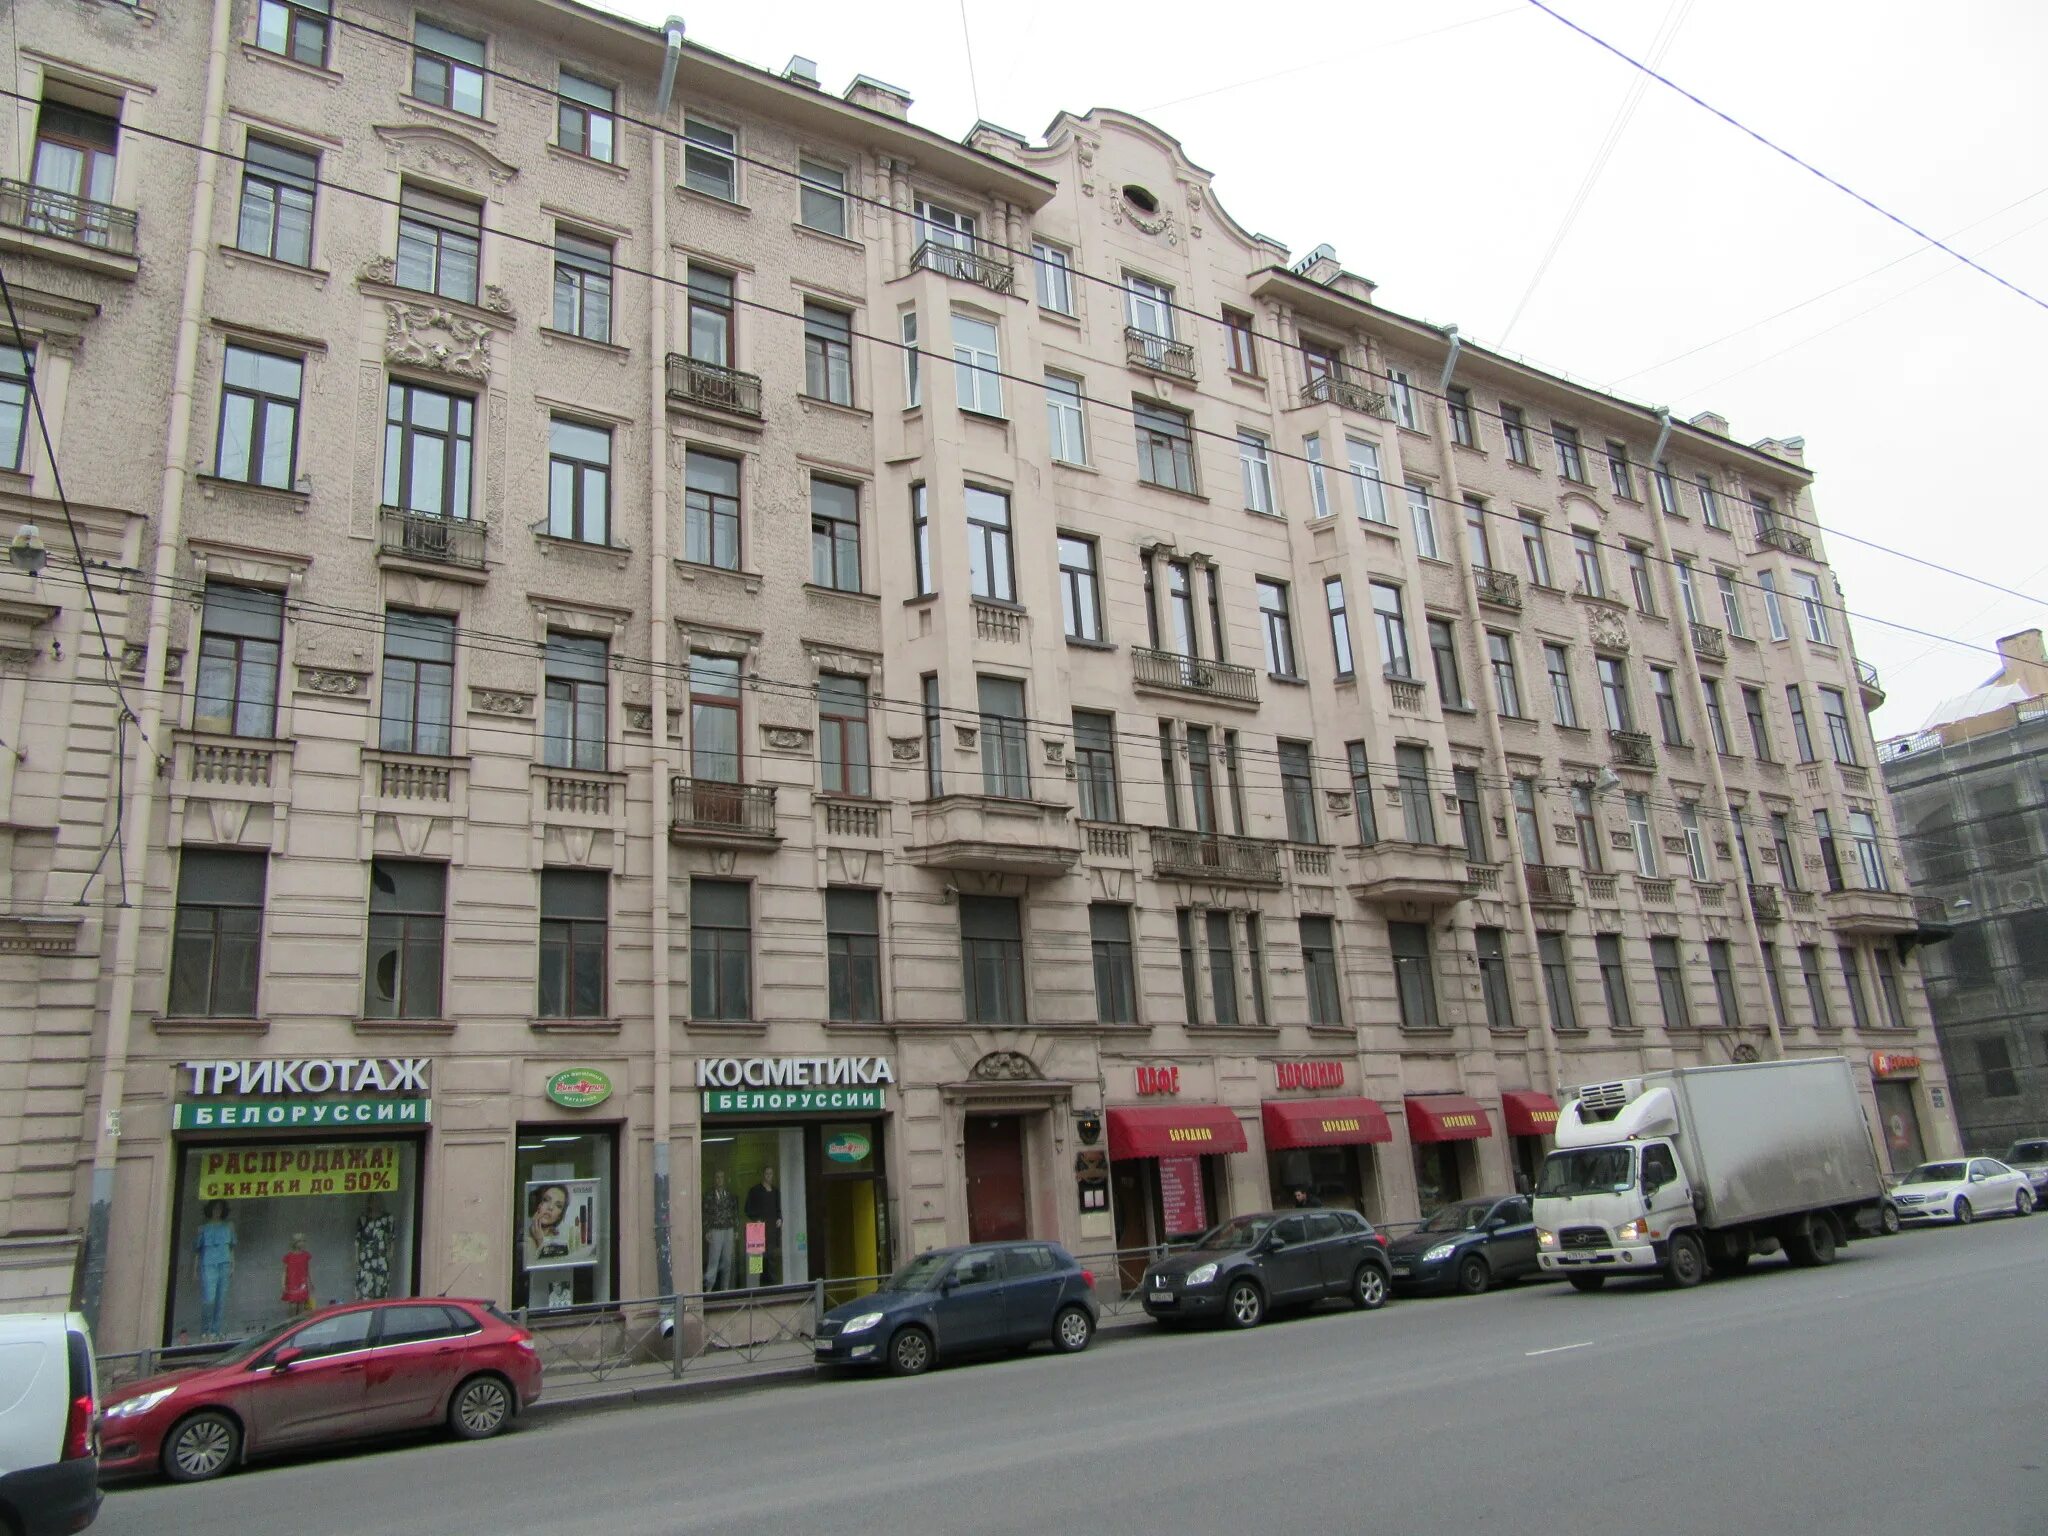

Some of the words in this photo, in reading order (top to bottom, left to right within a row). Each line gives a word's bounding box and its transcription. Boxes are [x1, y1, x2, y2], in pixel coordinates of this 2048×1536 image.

[186, 1059, 431, 1094] ТРИКОТАЖ
[697, 1057, 895, 1087] КОСМЕТИКА
[1136, 1067, 1180, 1095] КАФЕ
[1275, 1061, 1344, 1089] БОРОДИНО
[720, 1092, 874, 1109] БЕЛОРУССИИ
[196, 1103, 416, 1125] БЕЛОРУССИИ
[1322, 1119, 1359, 1132] БОРОДИНО
[1169, 1128, 1212, 1141] БОРОДИНО
[207, 1148, 393, 1175] РАСПРОДАЖА!
[344, 1171, 391, 1191] 50%
